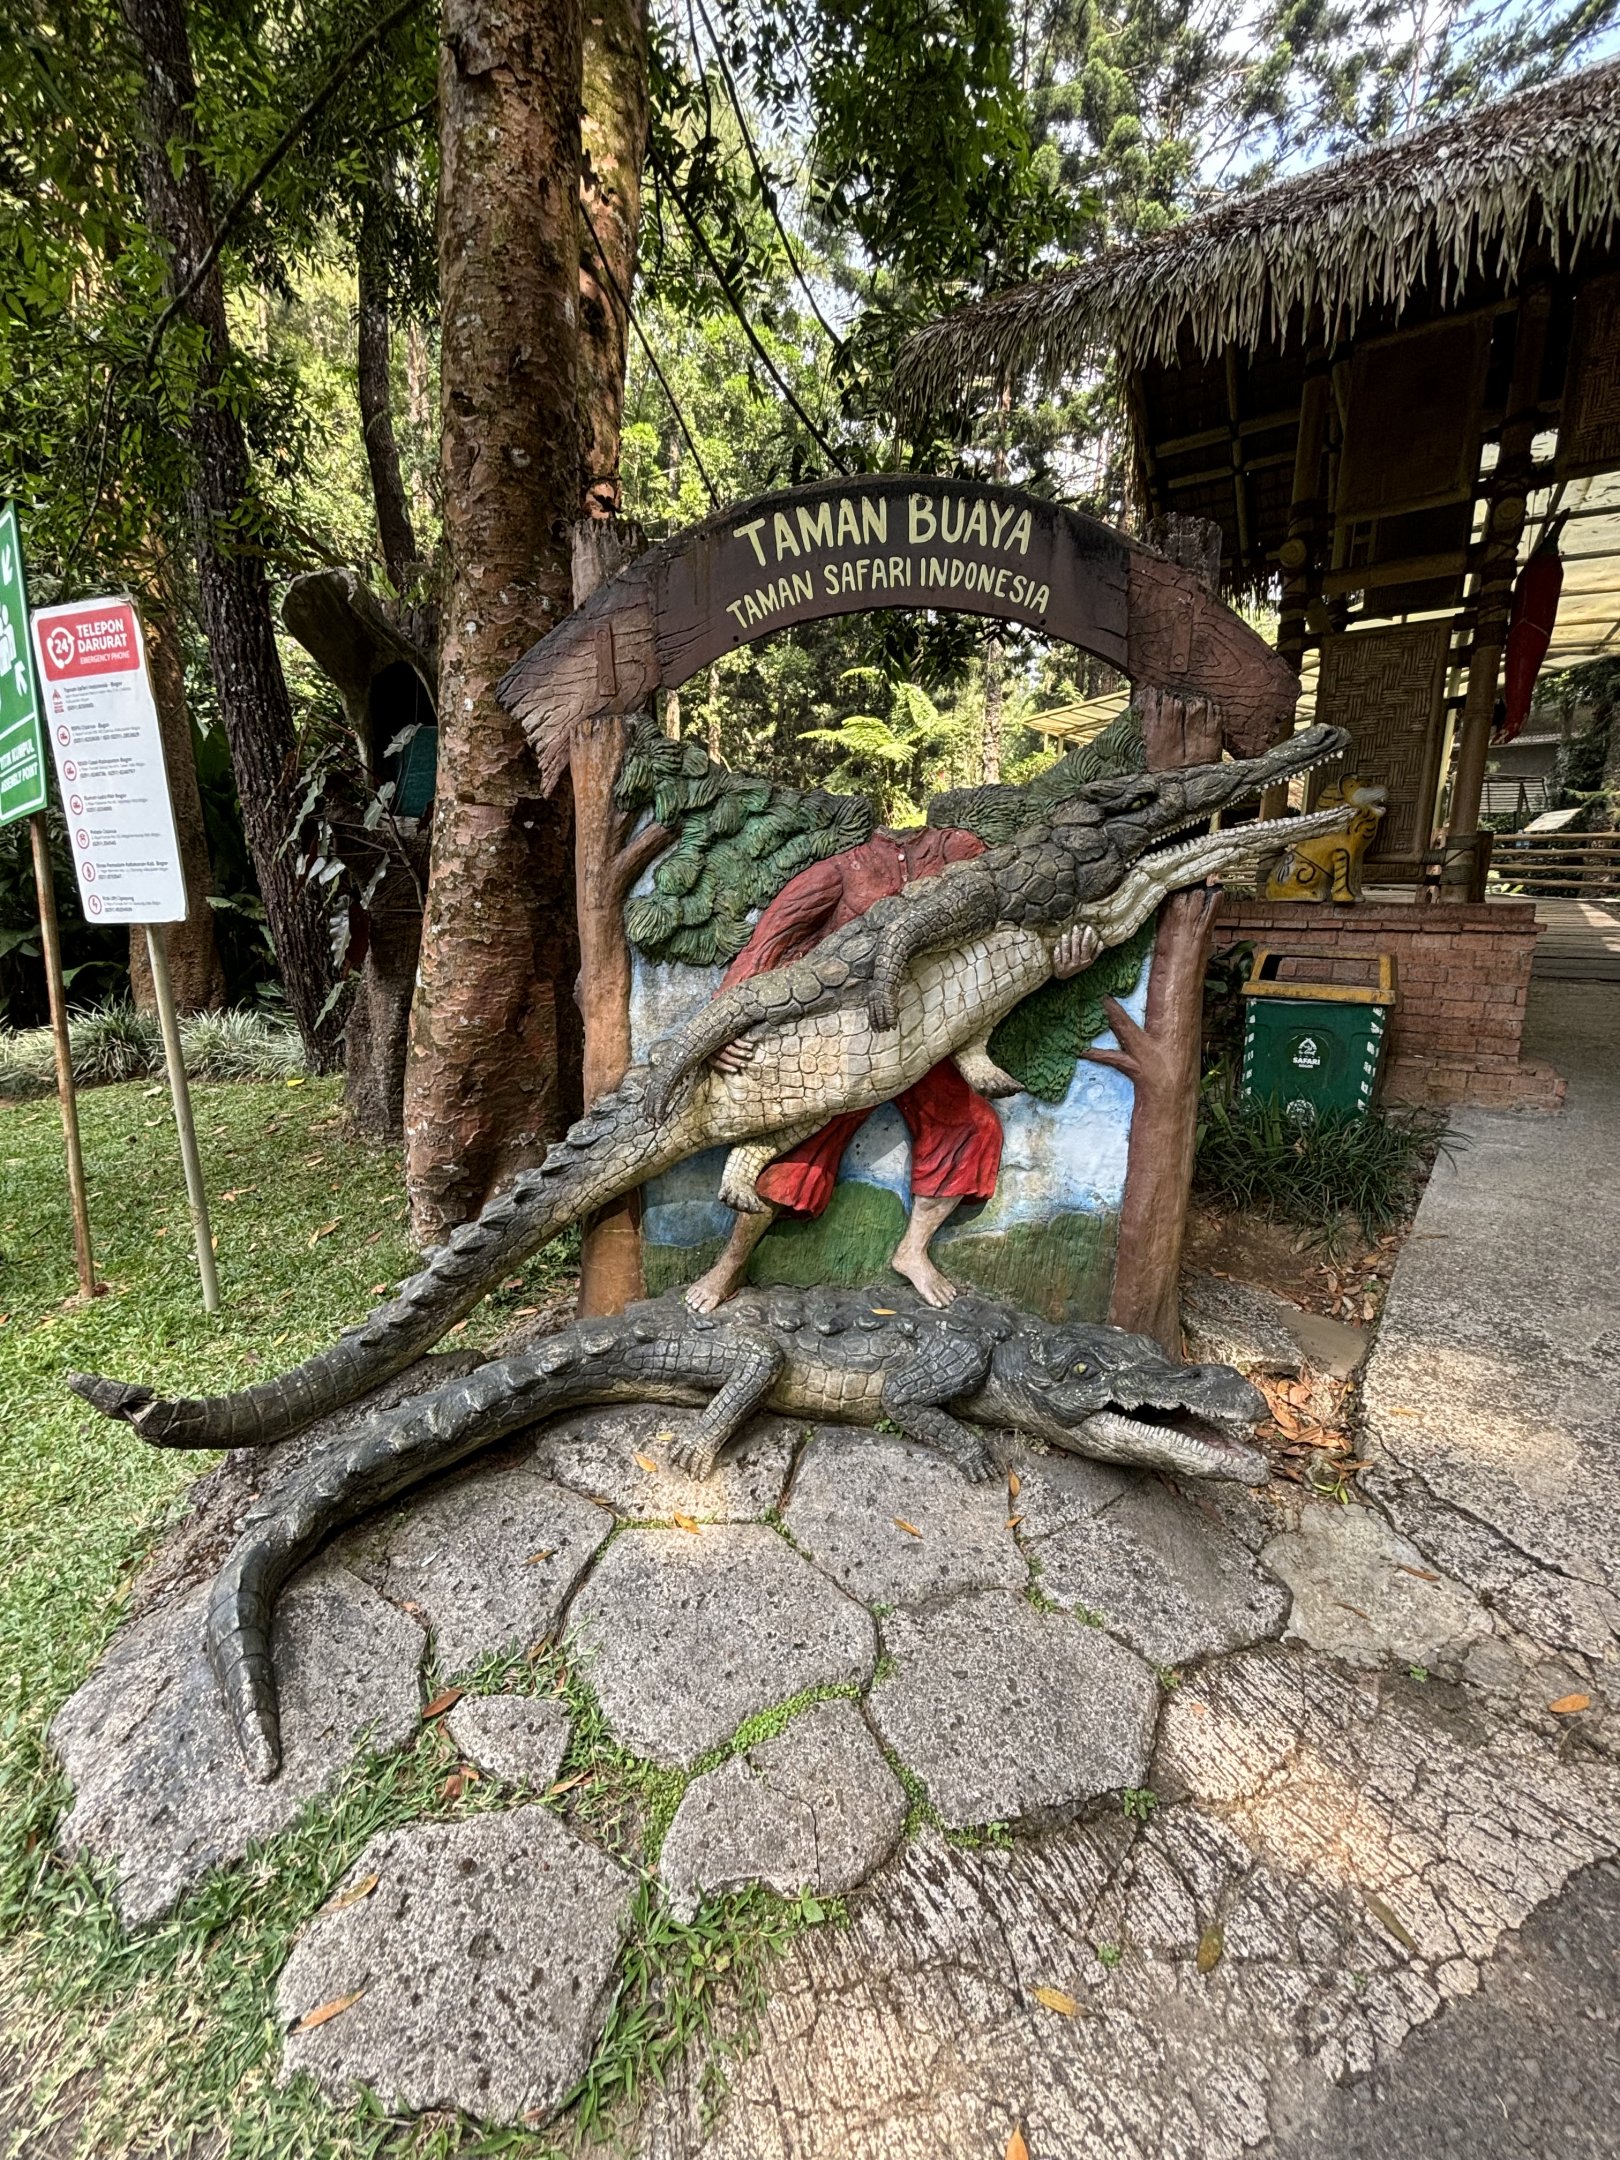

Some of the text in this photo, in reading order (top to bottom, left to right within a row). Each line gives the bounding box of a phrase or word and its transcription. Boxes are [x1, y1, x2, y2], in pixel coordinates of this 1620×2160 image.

[733, 492, 1032, 567] TAMAN BUAYA
[726, 556, 1051, 629] TAMAN SAFARI INDONESIA
[76, 618, 124, 638] TELEPON
[54, 638, 69, 654] 24
[77, 633, 127, 653] DARURAT
[1293, 1057, 1320, 1065] SAFARI
